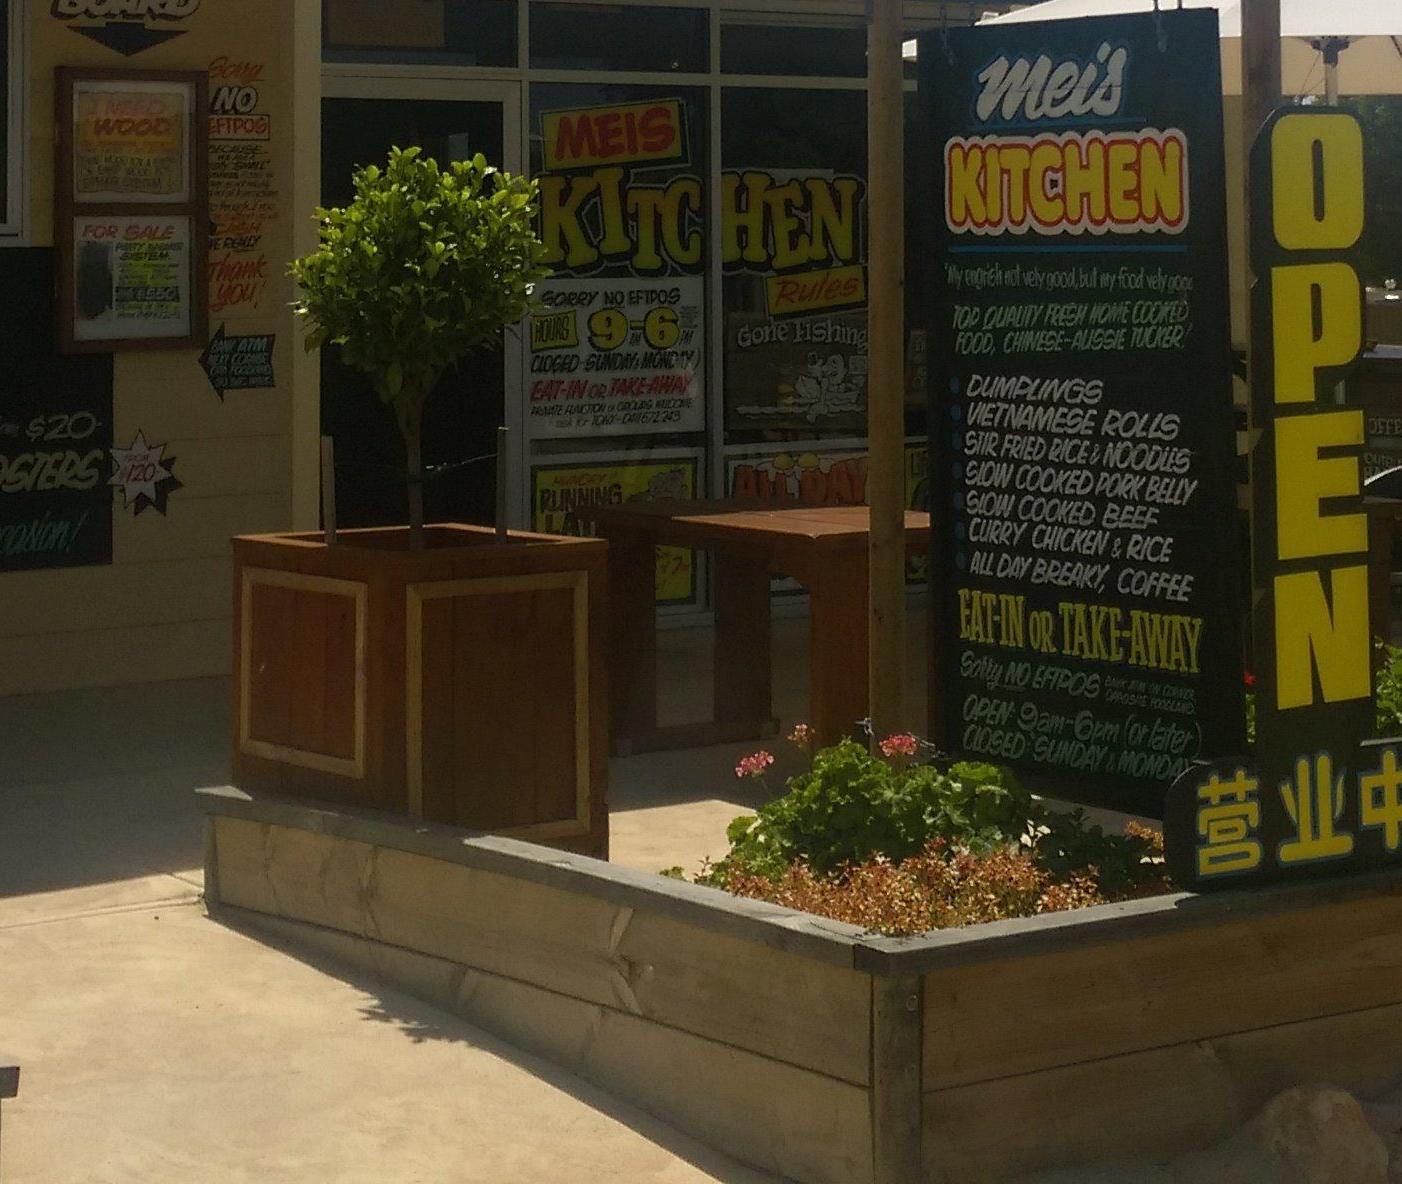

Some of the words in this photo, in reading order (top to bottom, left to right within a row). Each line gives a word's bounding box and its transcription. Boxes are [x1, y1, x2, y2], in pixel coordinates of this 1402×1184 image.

[211, 86, 258, 115] NO
[93, 117, 174, 136] WOOD
[554, 107, 676, 161] MEIS
[945, 128, 1189, 235] KITCHEN
[82, 224, 118, 239] FOR
[124, 223, 175, 241] SALE
[532, 164, 863, 272] KITCHEN
[209, 252, 268, 281] Thank
[1079, 267, 1097, 289] but
[1118, 267, 1145, 290] food
[541, 291, 598, 307] SORRY
[604, 290, 626, 306] NO
[629, 288, 681, 306] EFTPOS
[775, 272, 859, 306] Rules
[533, 316, 570, 343] HOURS
[953, 305, 981, 330] TOP
[982, 304, 1043, 331] QUALITY
[1044, 303, 1089, 327] FRESH
[1089, 301, 1131, 325] HOME
[1131, 299, 1190, 325] COOKED
[737, 321, 787, 348] Gone
[794, 318, 868, 351] Fishing
[955, 332, 996, 357] FOOD,
[1130, 323, 1193, 349] TUCKER!
[531, 354, 580, 374] CLOSED
[530, 379, 588, 402] EAT-IN
[608, 375, 693, 397] TAKE-AWAY
[965, 374, 1104, 405] DUMPLINGS
[966, 402, 1097, 435] VIETNAMESE
[1101, 409, 1181, 441] ROLLS
[1271, 113, 1373, 712] OPEN
[964, 430, 997, 458] STIR
[1000, 433, 1047, 461] FRIED
[1048, 438, 1090, 465] RICE
[1102, 440, 1193, 475] NOODLES
[965, 459, 1014, 490] SLOW
[1015, 464, 1095, 496] COOKED
[1095, 470, 1146, 500] PORK
[1146, 475, 1198, 507] BELLY
[966, 490, 1016, 518] SLOW
[1017, 494, 1096, 526] COOKED
[1102, 502, 1161, 530] BEEF
[968, 517, 1028, 546] CURRY
[1031, 524, 1111, 556] CHICKEN
[1126, 534, 1174, 563] RICE
[970, 551, 995, 576] ALL
[996, 553, 1031, 579] DAY
[1030, 558, 1111, 594] BREAKY,
[1117, 568, 1195, 602] COFFEE
[957, 588, 1025, 647] EAT-IN
[1029, 611, 1057, 653] OR
[1058, 602, 1202, 674] TAKE-AWAY
[960, 650, 1004, 689] Sorry
[1004, 661, 1031, 687] NO
[1032, 666, 1100, 698] EFTPOS
[1033, 735, 1108, 770] SUNDAY
